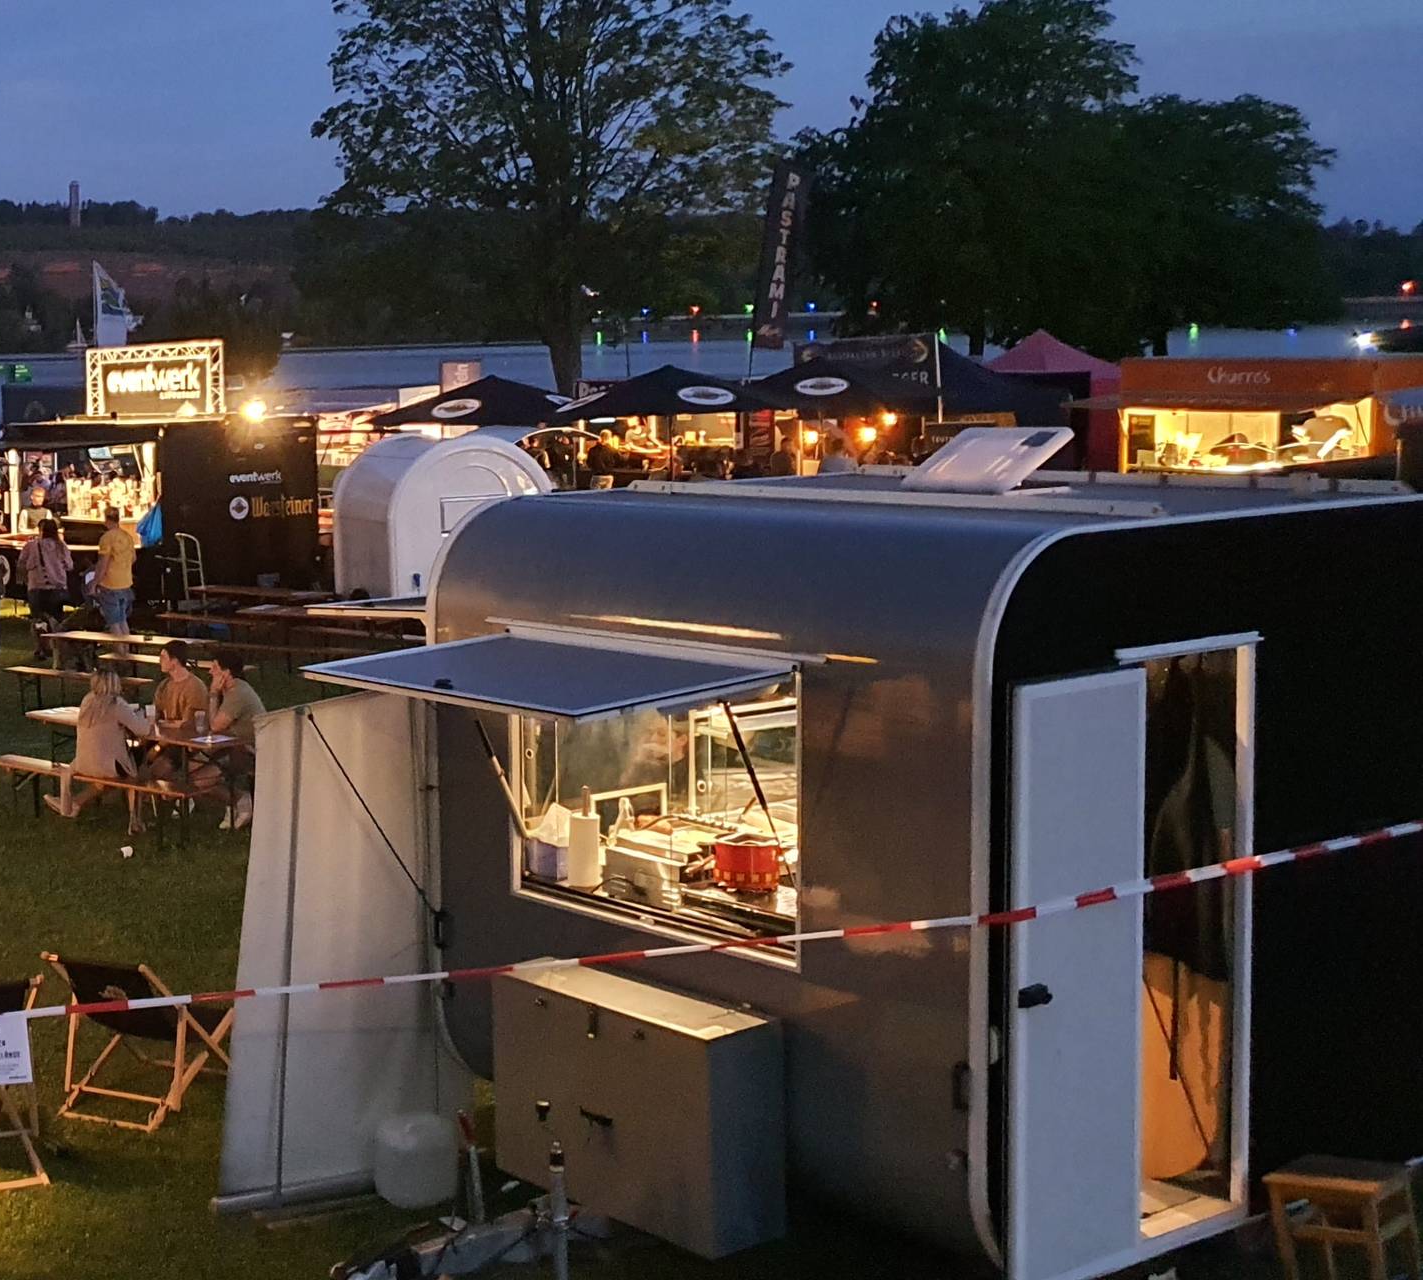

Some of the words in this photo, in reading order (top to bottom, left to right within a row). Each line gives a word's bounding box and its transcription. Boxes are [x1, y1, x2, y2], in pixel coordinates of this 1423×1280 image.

[768, 171, 801, 319] PASTRAMI
[106, 360, 201, 394] eventwerk
[1206, 365, 1271, 385] Churros
[229, 469, 282, 484] eventwerk
